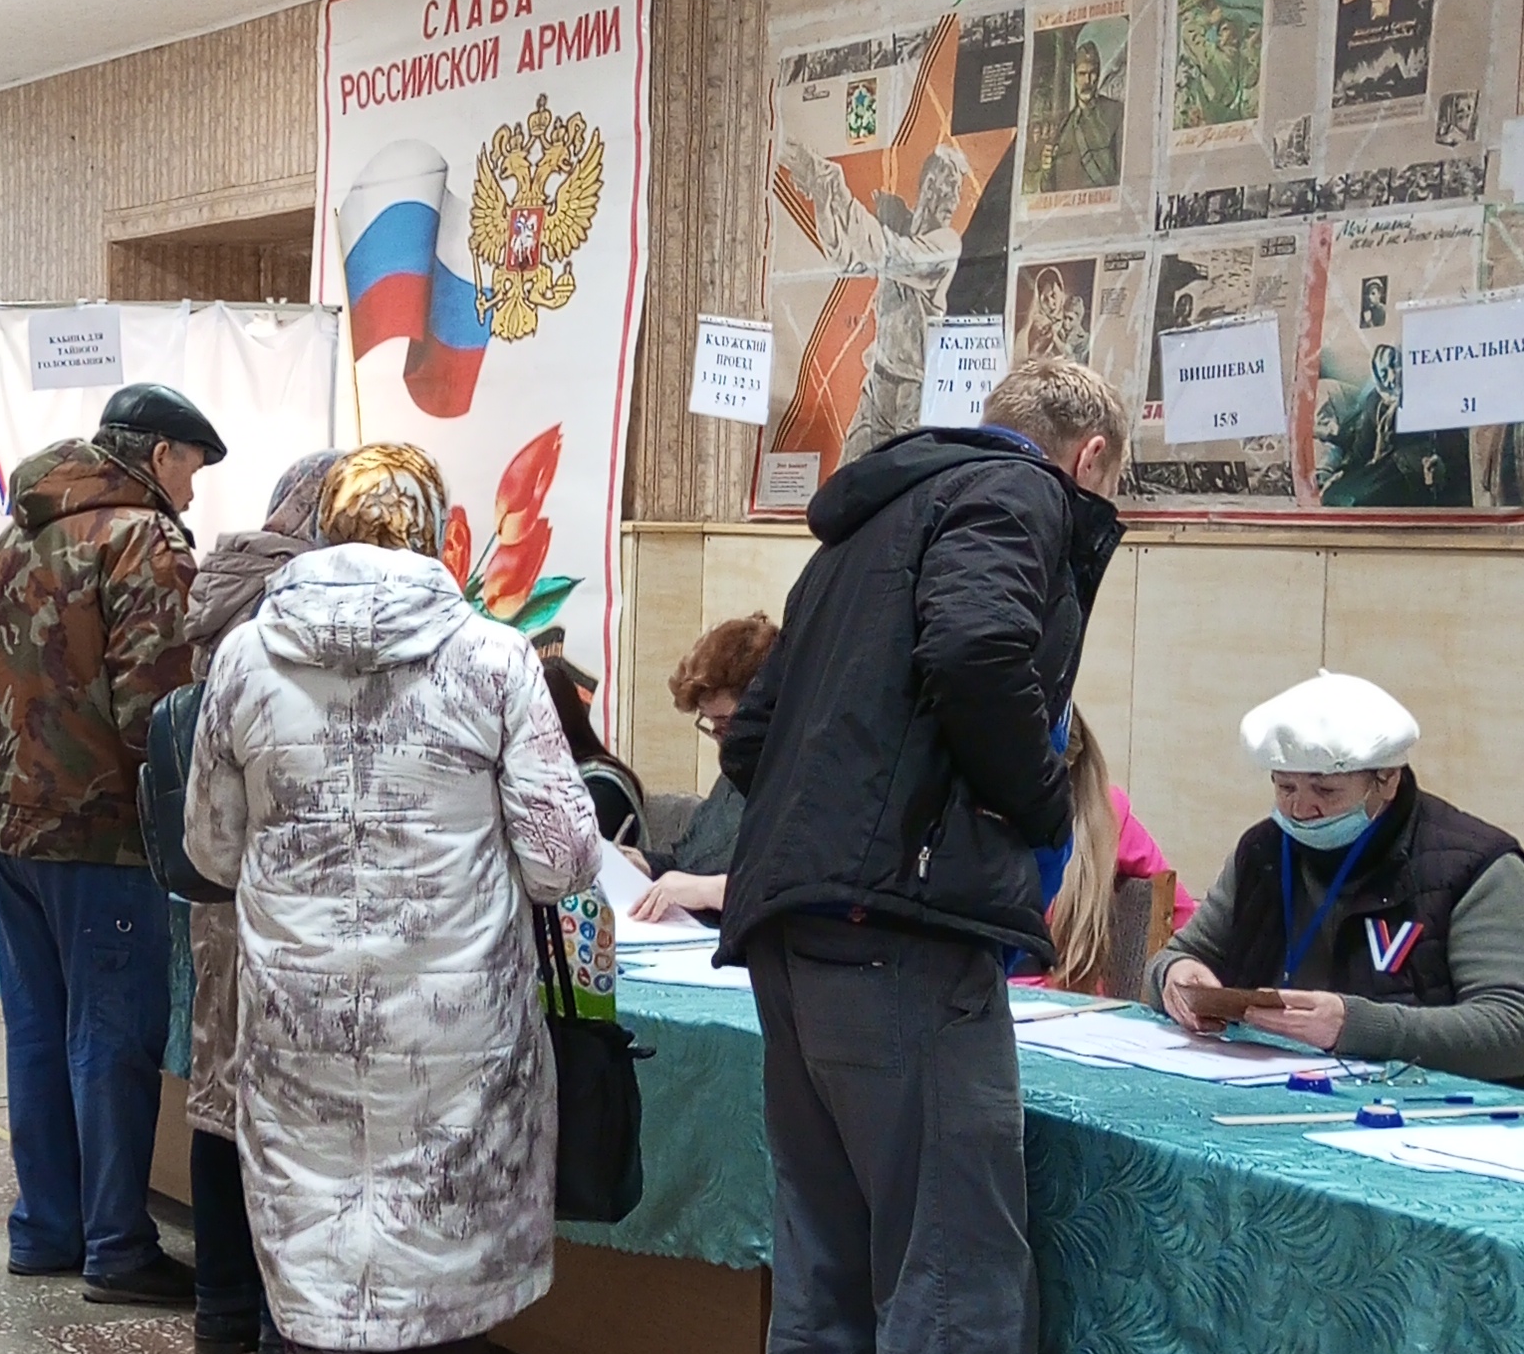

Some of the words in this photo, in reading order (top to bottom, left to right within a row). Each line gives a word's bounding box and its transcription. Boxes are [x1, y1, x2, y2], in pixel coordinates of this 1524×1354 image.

[340, 34, 501, 115] РОССИЙСКОЙ
[515, 5, 621, 75] АРМИИ
[704, 332, 767, 353] КАЛУЖСКИЙ
[1408, 337, 1524, 366] ТЕАТРАЛЬНА
[715, 353, 753, 371] ПРОЕЗД
[1178, 358, 1265, 383] ВИШНЕВАЯ
[937, 379, 954, 393] 7/1
[965, 380, 973, 393] 9
[1460, 396, 1477, 414] 31
[1213, 411, 1239, 428] 15/8
